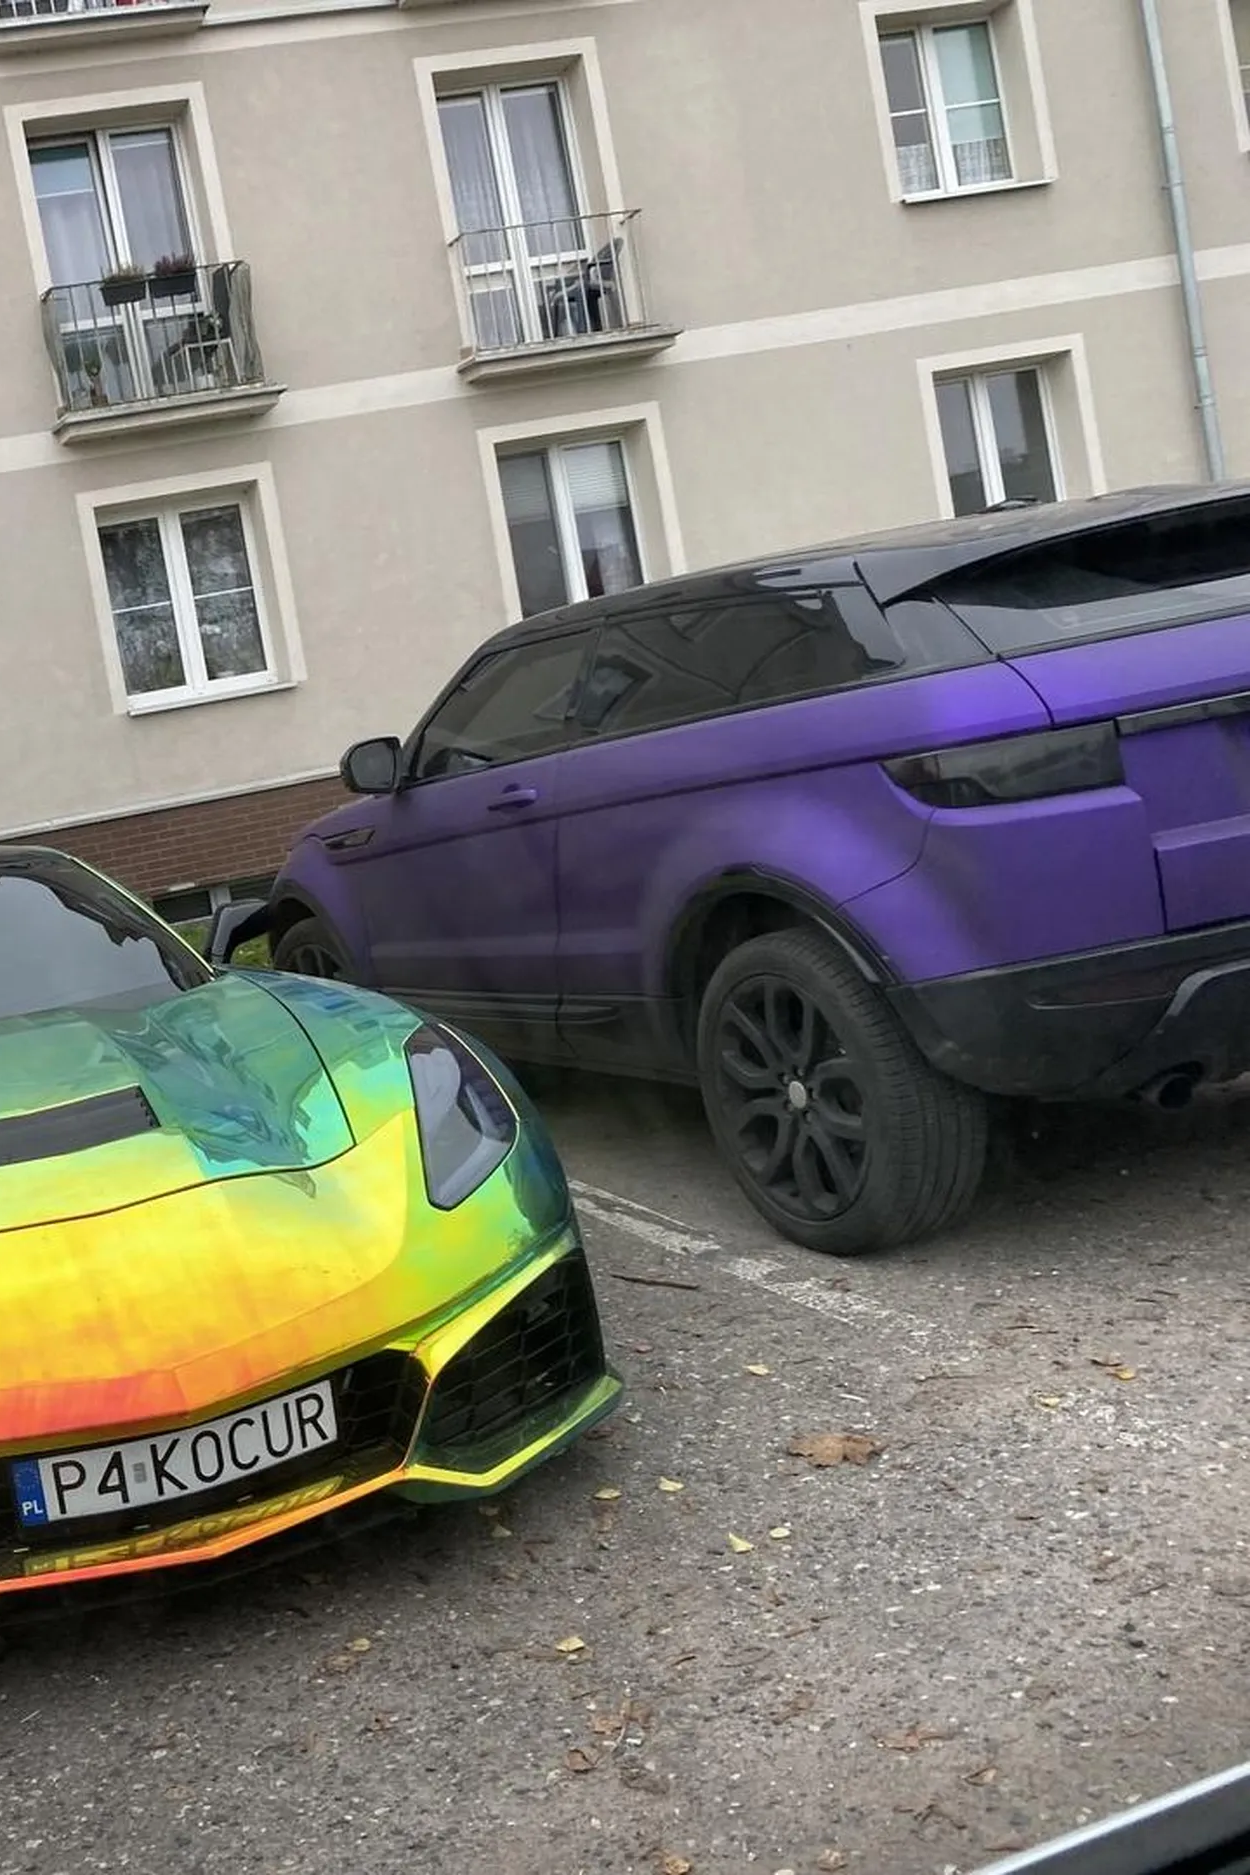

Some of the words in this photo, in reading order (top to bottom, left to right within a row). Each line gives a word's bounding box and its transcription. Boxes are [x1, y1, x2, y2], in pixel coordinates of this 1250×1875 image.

[51, 1451, 130, 1515] P4
[150, 1392, 330, 1496] KOCUR
[21, 1499, 44, 1516] PL
